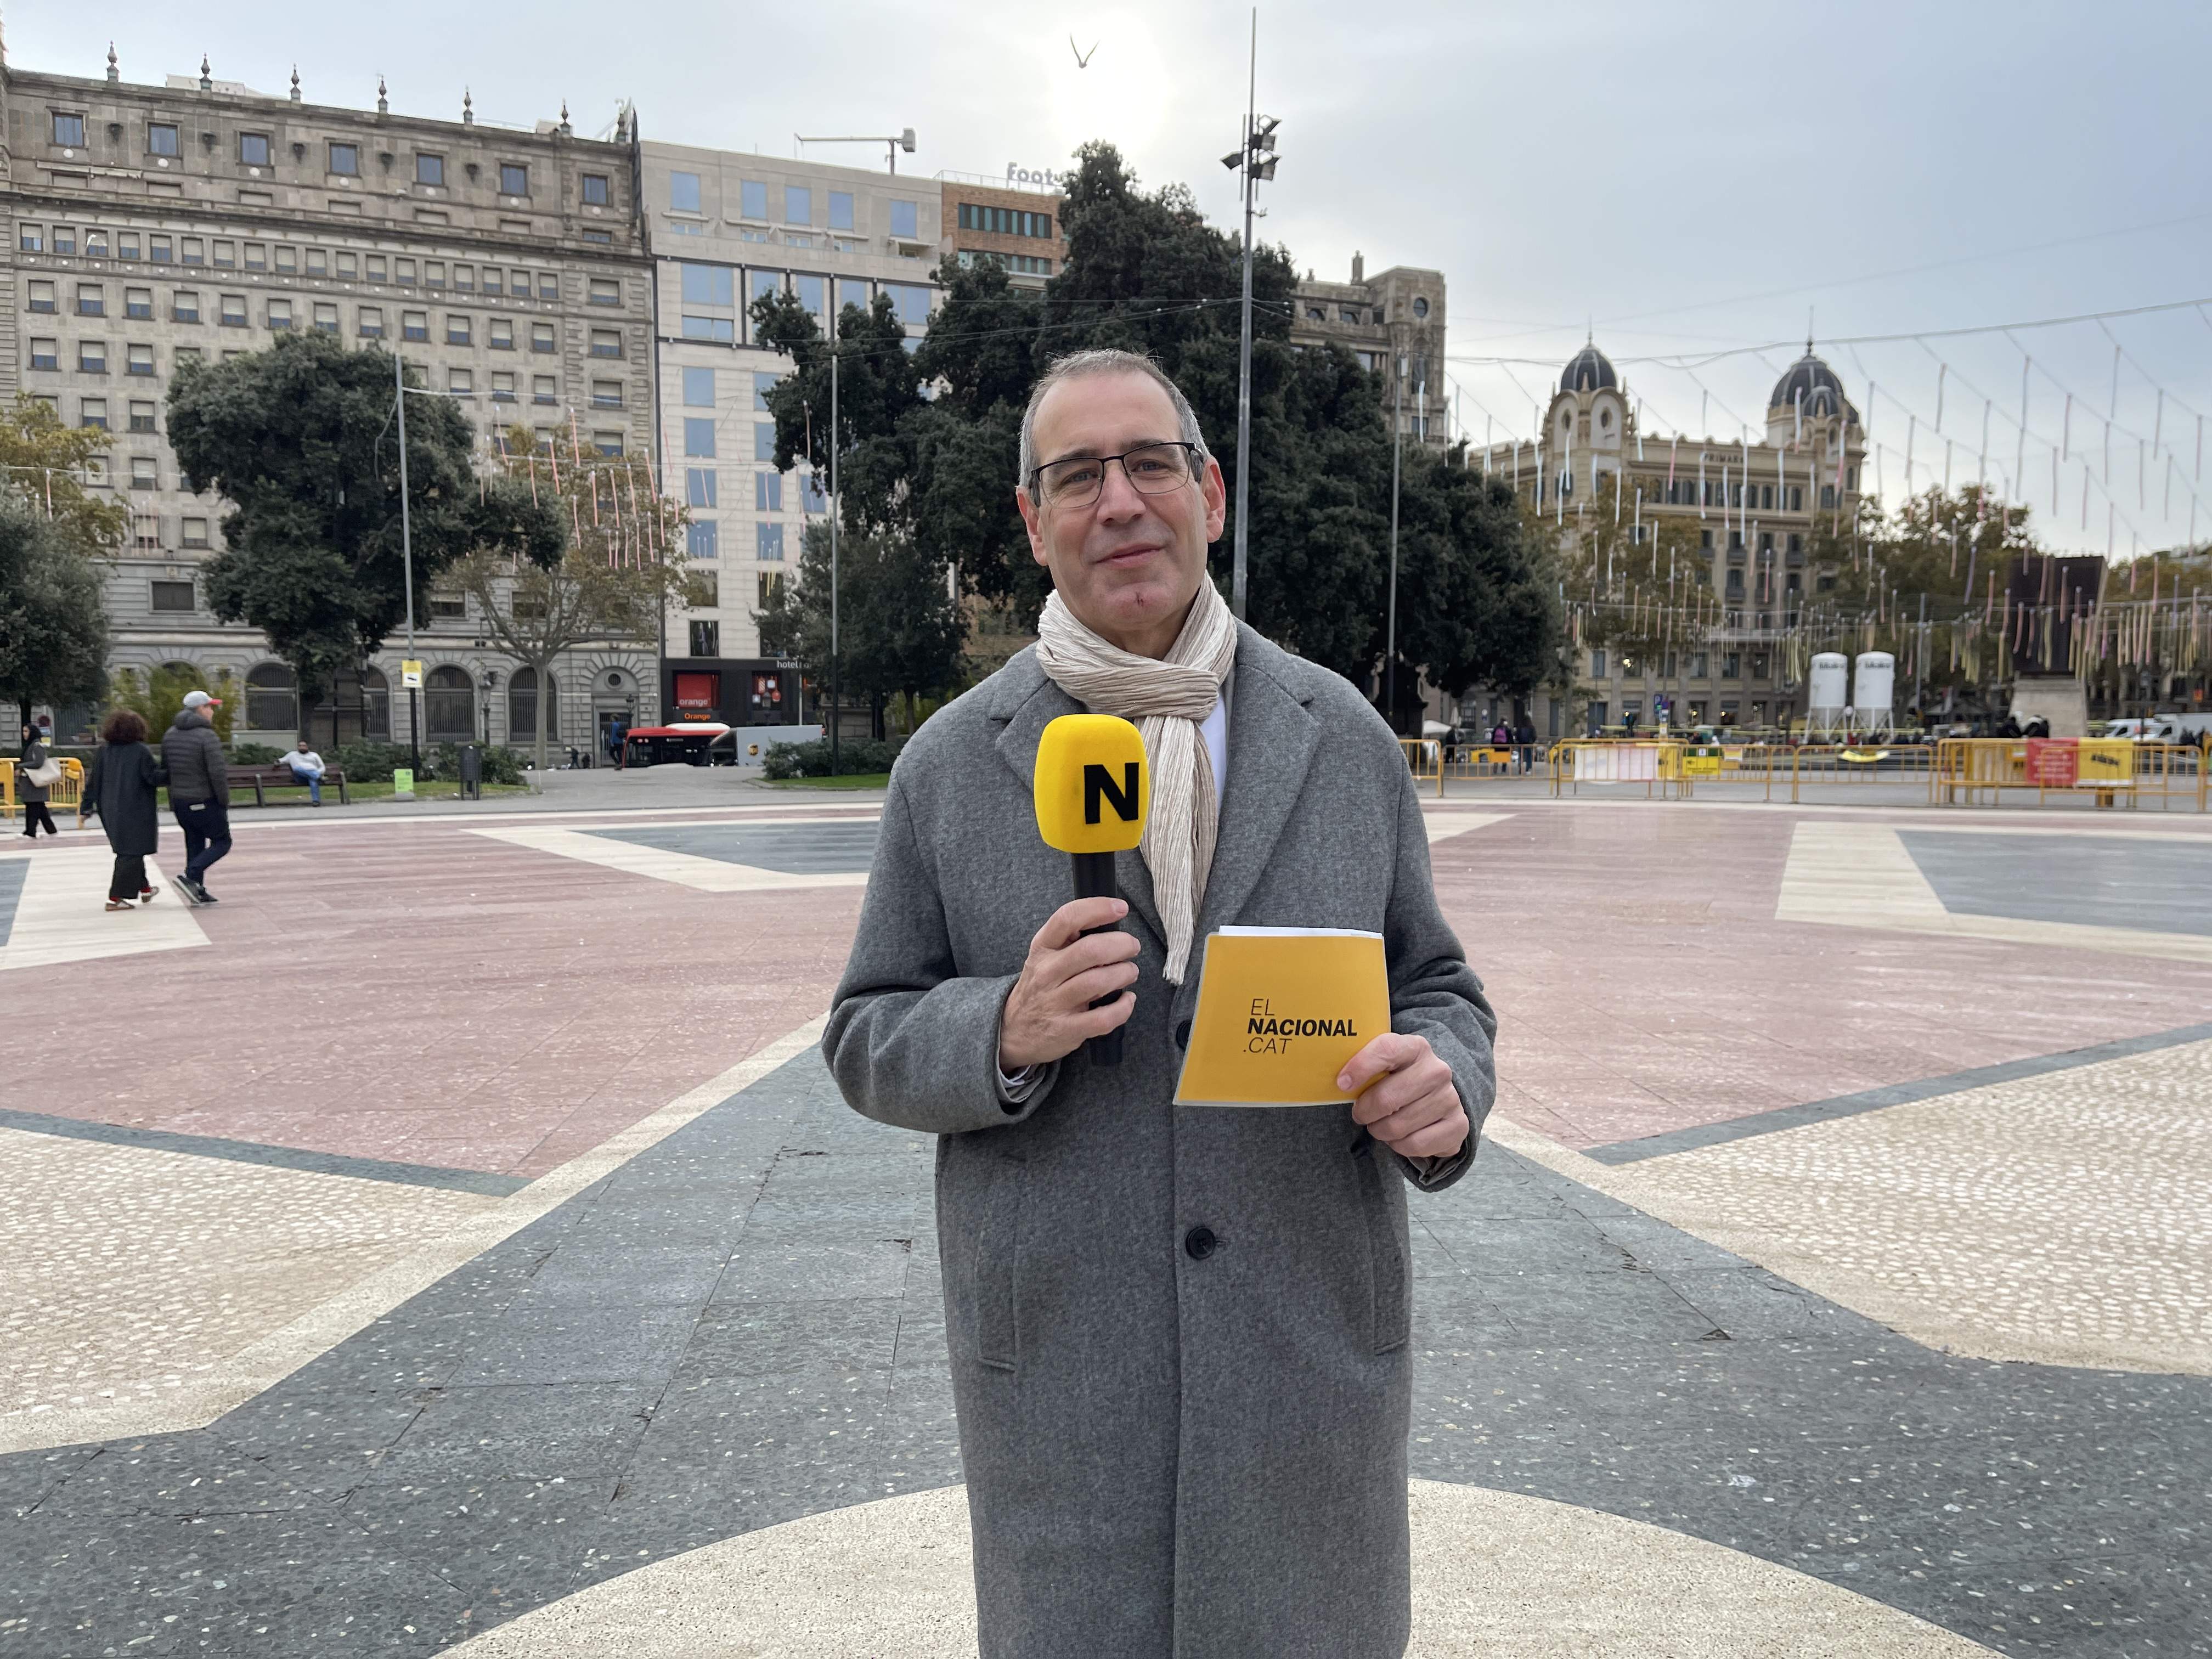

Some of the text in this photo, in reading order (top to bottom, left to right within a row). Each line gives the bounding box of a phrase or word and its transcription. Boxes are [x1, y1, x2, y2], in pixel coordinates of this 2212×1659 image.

[777, 660, 798, 668] hotel
[680, 698, 708, 707] orange
[1084, 762, 1139, 824] N
[1251, 998, 1275, 1015] EL
[1247, 1018, 1357, 1036] NACIONAL
[1243, 1037, 1293, 1054] .CAT
